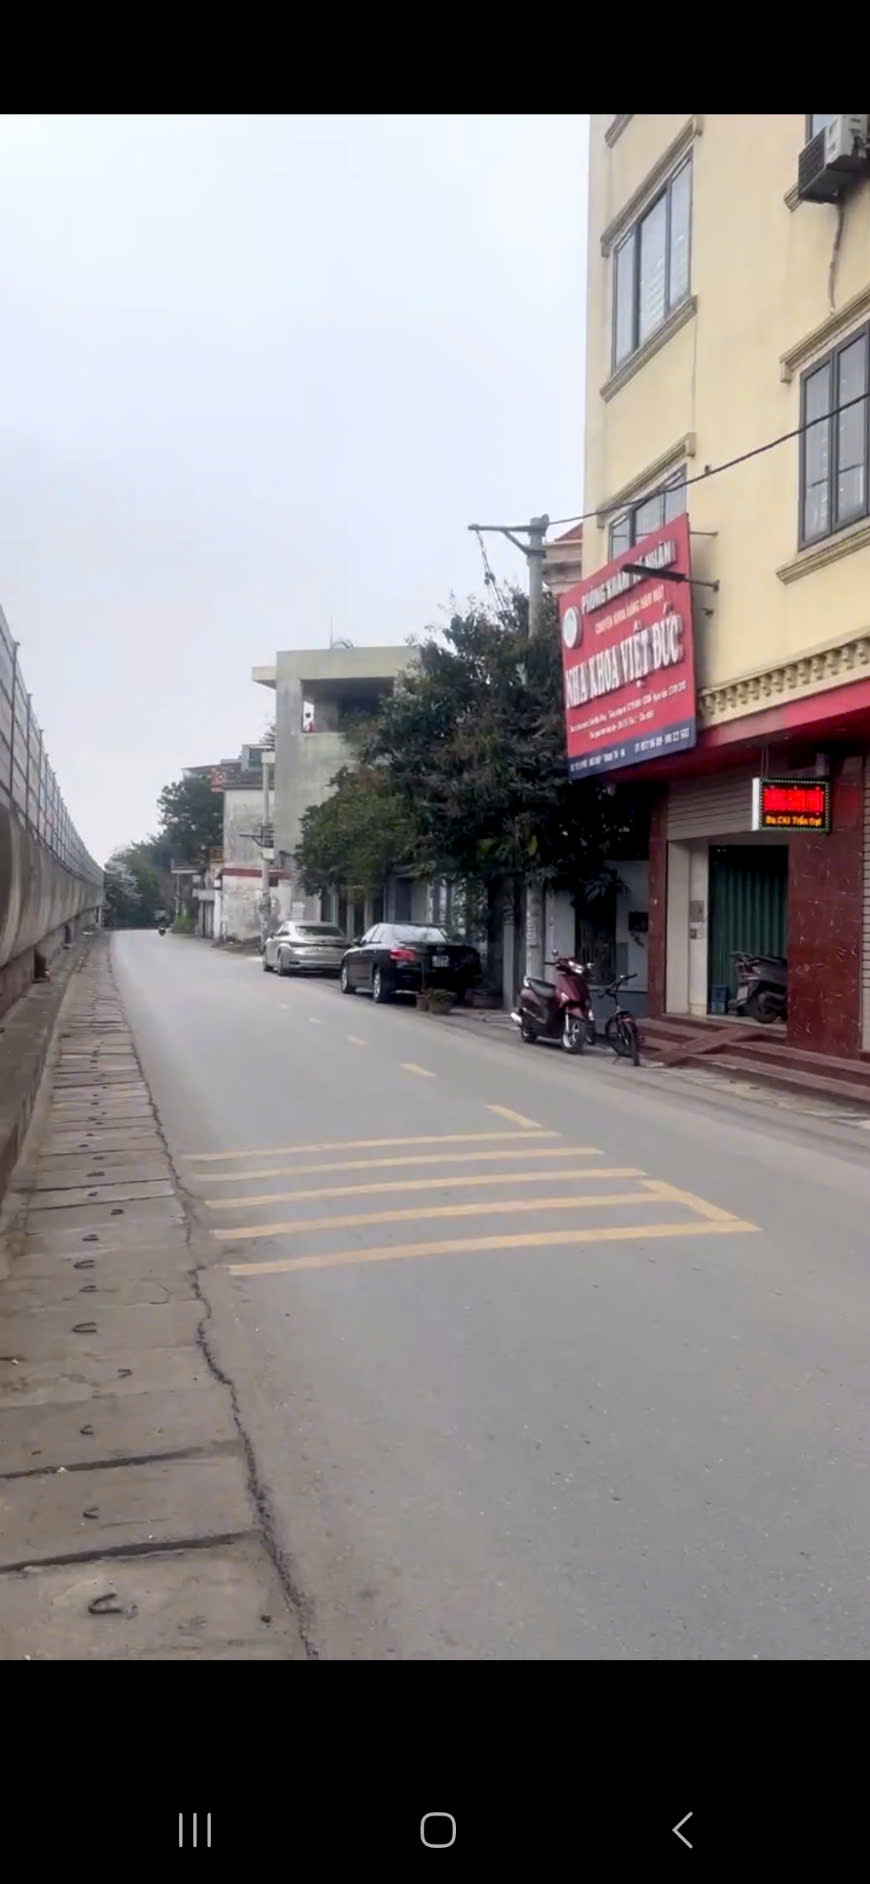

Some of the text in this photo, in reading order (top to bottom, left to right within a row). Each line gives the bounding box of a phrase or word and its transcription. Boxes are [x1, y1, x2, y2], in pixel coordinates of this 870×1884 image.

[565, 661, 588, 710] NHA
[588, 644, 620, 699] KHOA
[620, 620, 649, 688] VIỆT
[652, 602, 680, 670] ĐỨC
